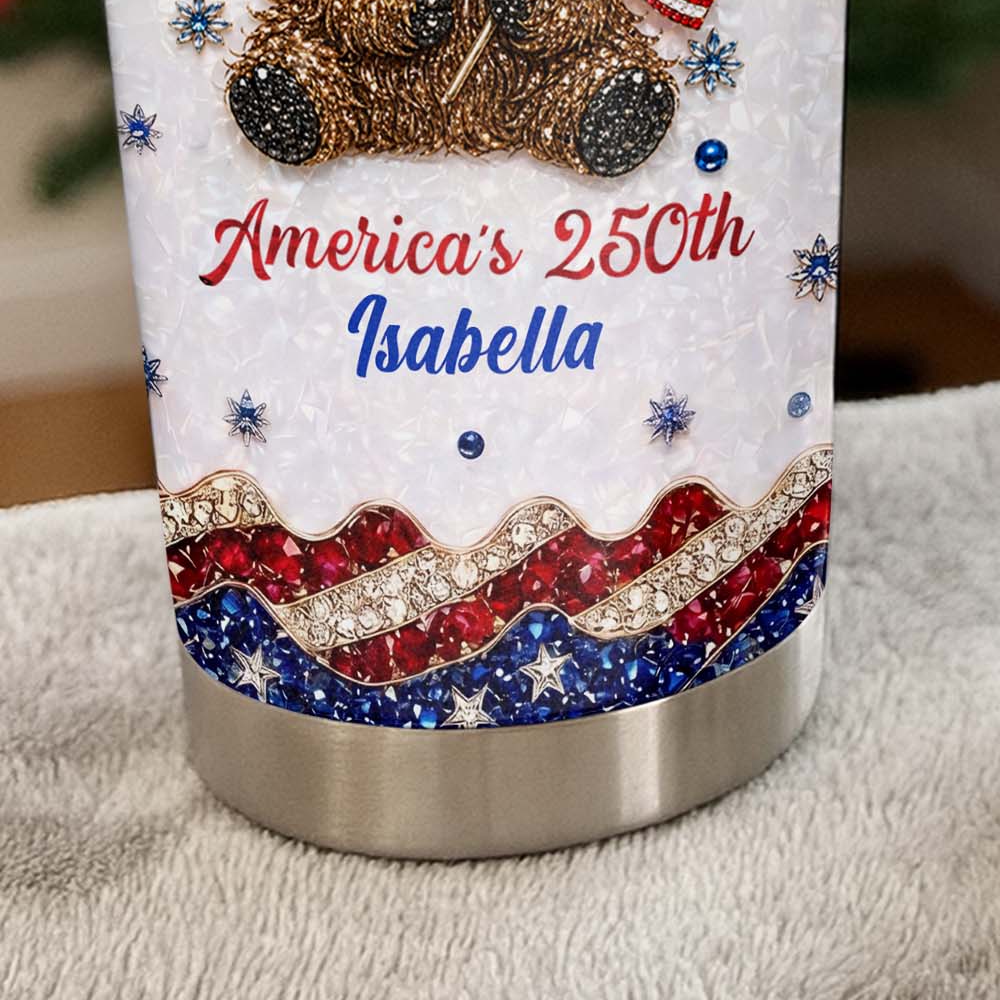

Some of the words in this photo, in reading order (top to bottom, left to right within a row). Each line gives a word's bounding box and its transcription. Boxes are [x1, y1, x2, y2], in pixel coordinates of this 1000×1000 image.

[199, 198, 522, 287] America's
[544, 191, 756, 281] 250th
[347, 293, 604, 378] Isabella
